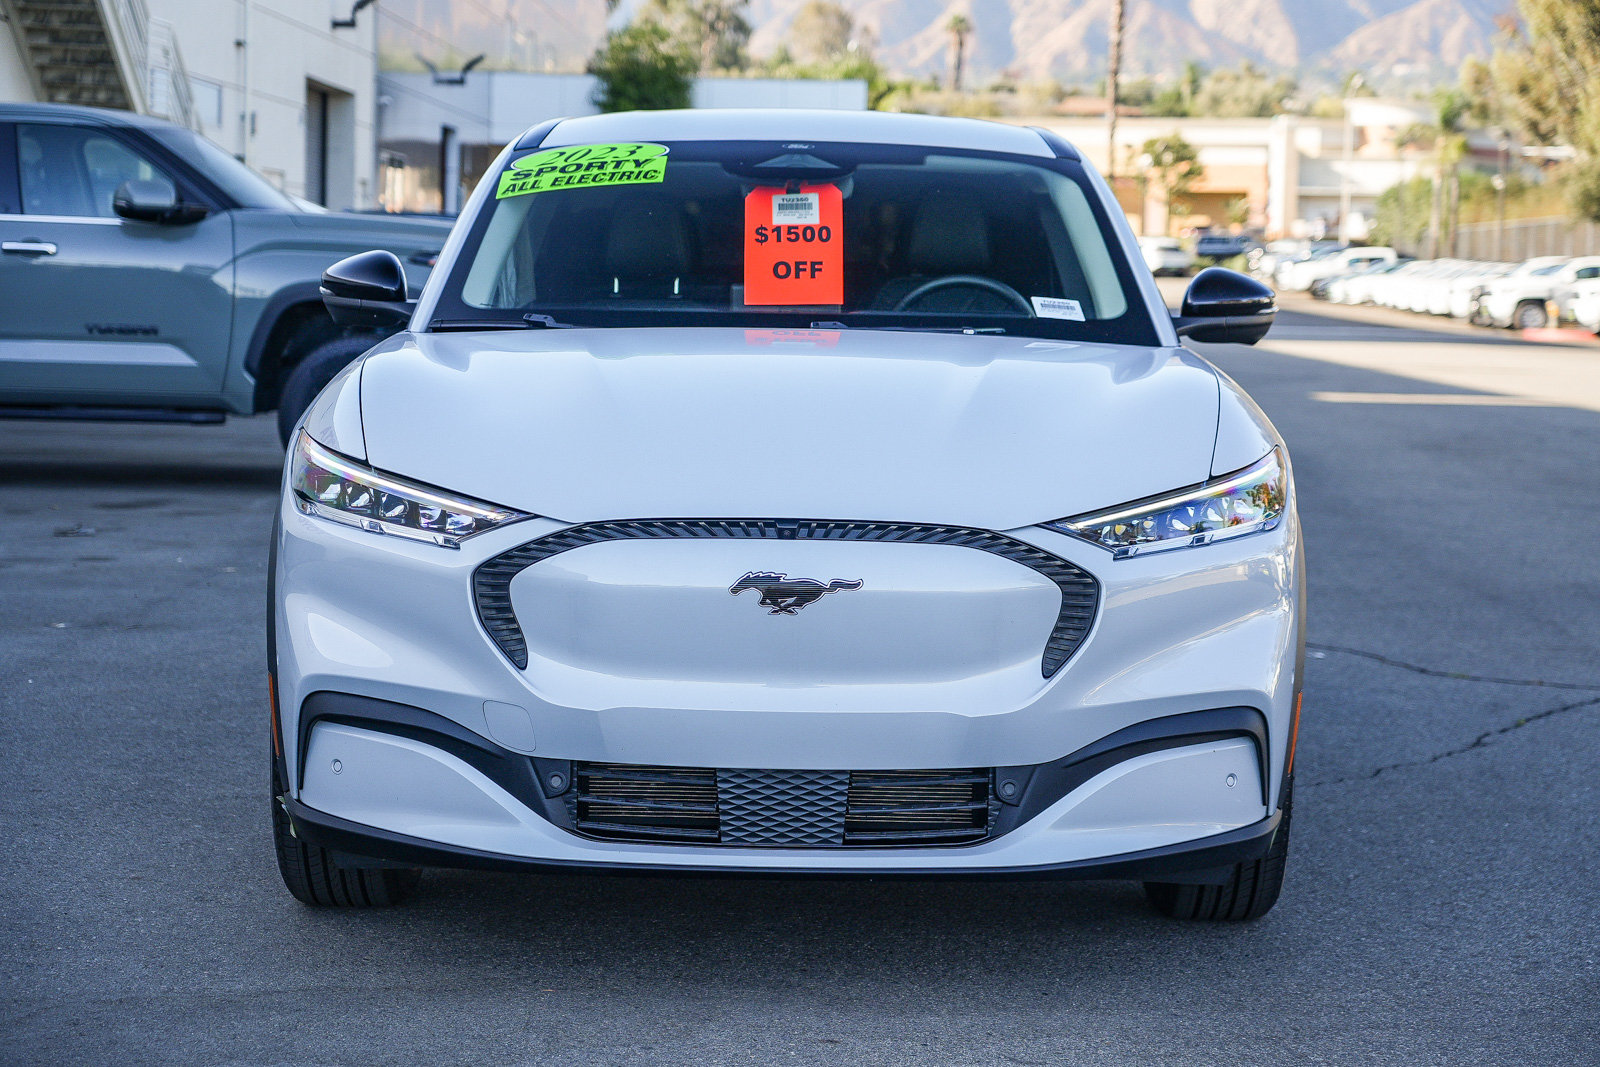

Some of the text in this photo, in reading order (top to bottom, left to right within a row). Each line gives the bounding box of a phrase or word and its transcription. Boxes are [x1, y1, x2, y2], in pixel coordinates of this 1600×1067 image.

[540, 145, 644, 166] 2023
[510, 158, 655, 181] SPORTY
[501, 169, 660, 195] ALL ELECTRIC
[755, 224, 832, 246] $1500
[772, 261, 824, 280] OFF
